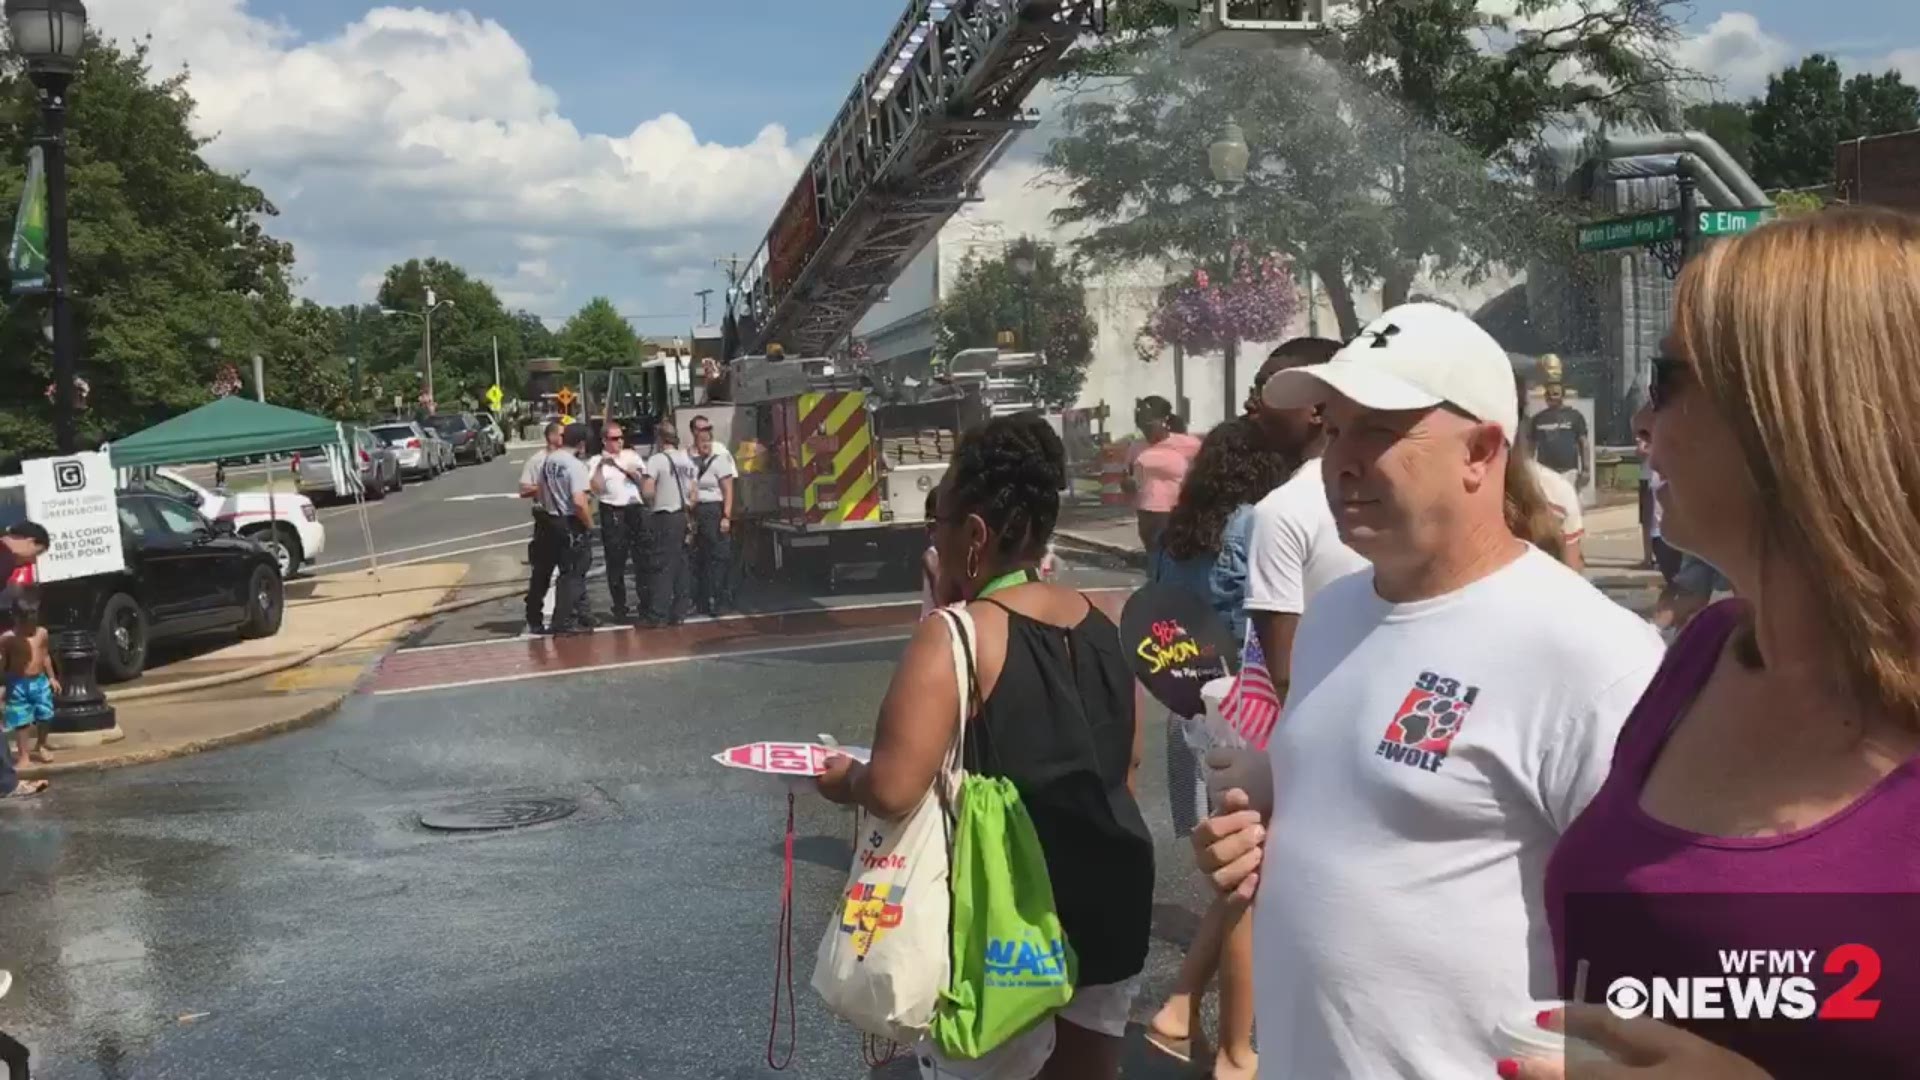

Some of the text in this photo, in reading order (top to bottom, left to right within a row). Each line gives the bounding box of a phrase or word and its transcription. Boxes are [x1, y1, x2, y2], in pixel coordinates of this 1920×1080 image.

[1699, 211, 1747, 232] S Elm
[61, 525, 115, 540] ALCOHOL
[54, 537, 103, 551] BEYOND
[48, 545, 112, 561] THIS POINT
[1384, 740, 1448, 773] WOLF
